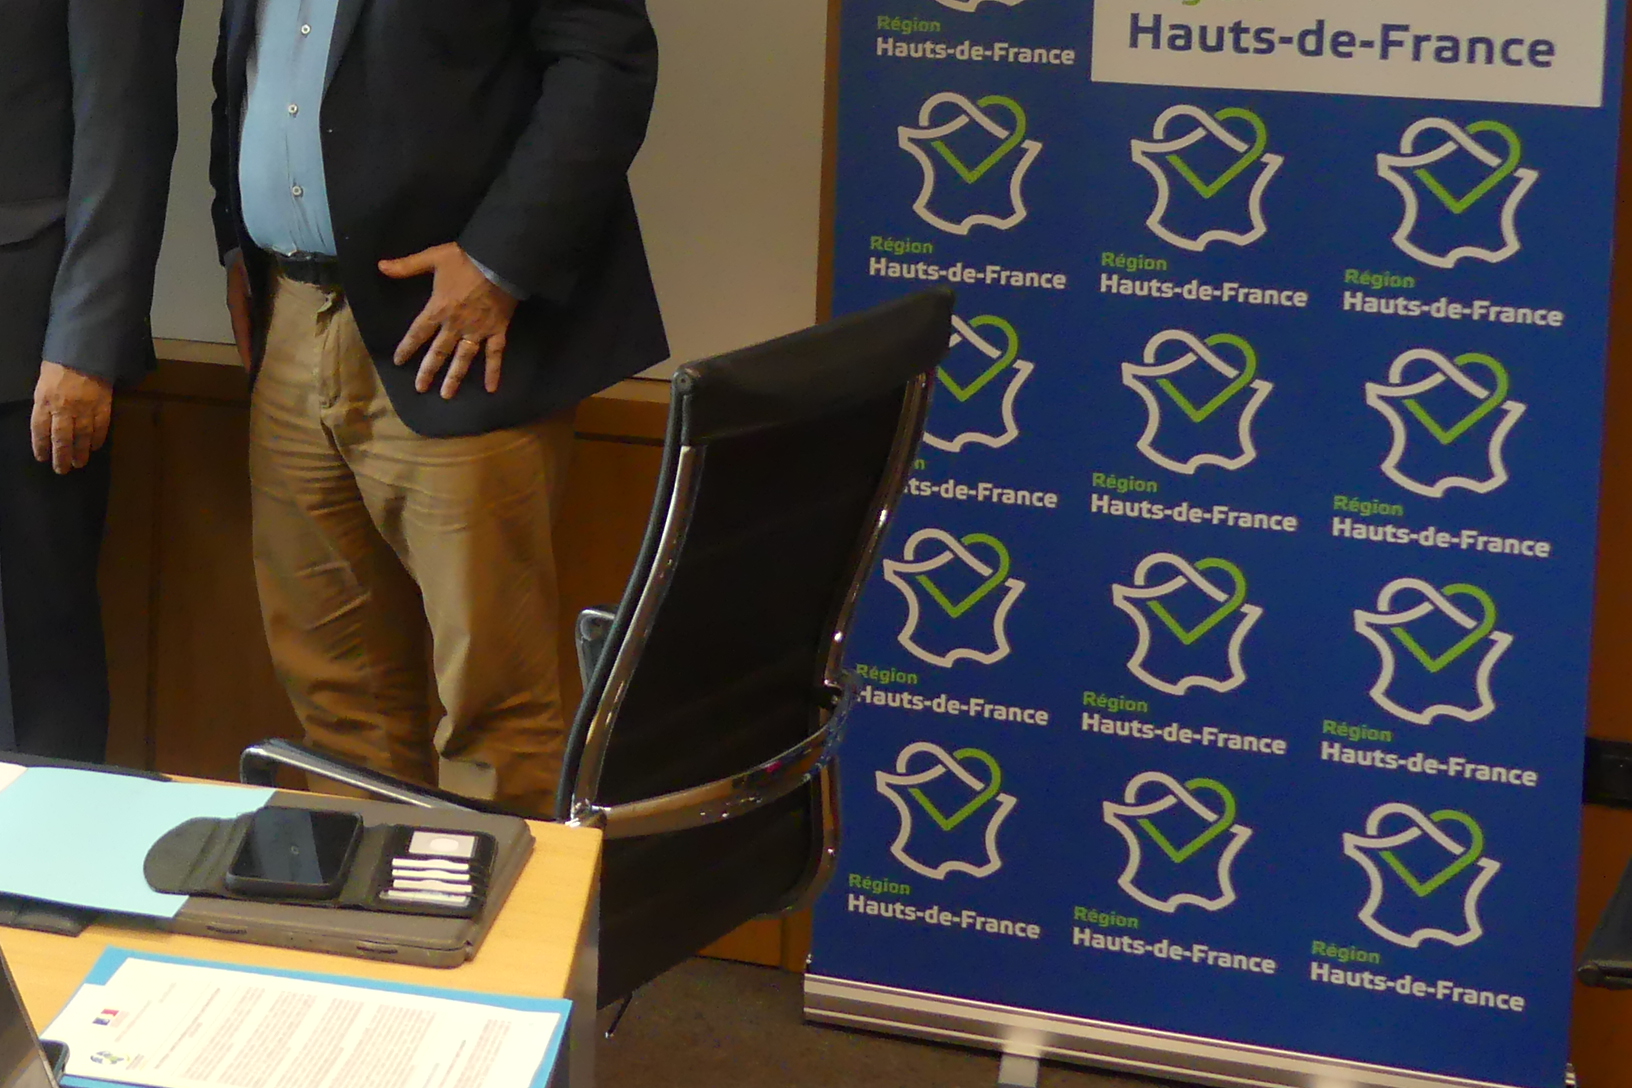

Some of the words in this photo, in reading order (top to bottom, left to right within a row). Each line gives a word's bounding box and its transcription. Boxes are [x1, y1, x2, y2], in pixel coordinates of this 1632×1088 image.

[878, 16, 940, 34] Région
[877, 38, 1074, 64] Hauts-de-France
[1128, 12, 1556, 68] Hauts-de-France
[871, 236, 933, 255] Région
[870, 258, 1066, 289] Hauts-de-France
[1102, 252, 1167, 272] Région
[1101, 274, 1307, 306] Hauts-de-France
[1345, 269, 1415, 289] Région
[1344, 292, 1563, 326] Hauts-de-France
[905, 478, 1057, 507] ts-de-France
[1093, 473, 1157, 493] Région
[1092, 494, 1297, 531] Hauts-de-France
[1334, 495, 1403, 516] Région
[1333, 517, 1550, 557] Hauts-de-France
[857, 664, 917, 684] Région
[857, 686, 1048, 725] Hauts-de-France
[1083, 692, 1147, 712] Région
[1083, 713, 1286, 754] Hauts-de-France
[1323, 720, 1391, 742] Région
[1322, 742, 1537, 786] Hauts-de-France
[849, 874, 910, 894] Région
[849, 894, 1039, 938] Hauts-de-France
[1075, 907, 1138, 928] Région
[1074, 927, 1275, 973] Hauts-de-France
[1312, 941, 1380, 963] Région
[1311, 962, 1524, 1011] Hauts-de-France
